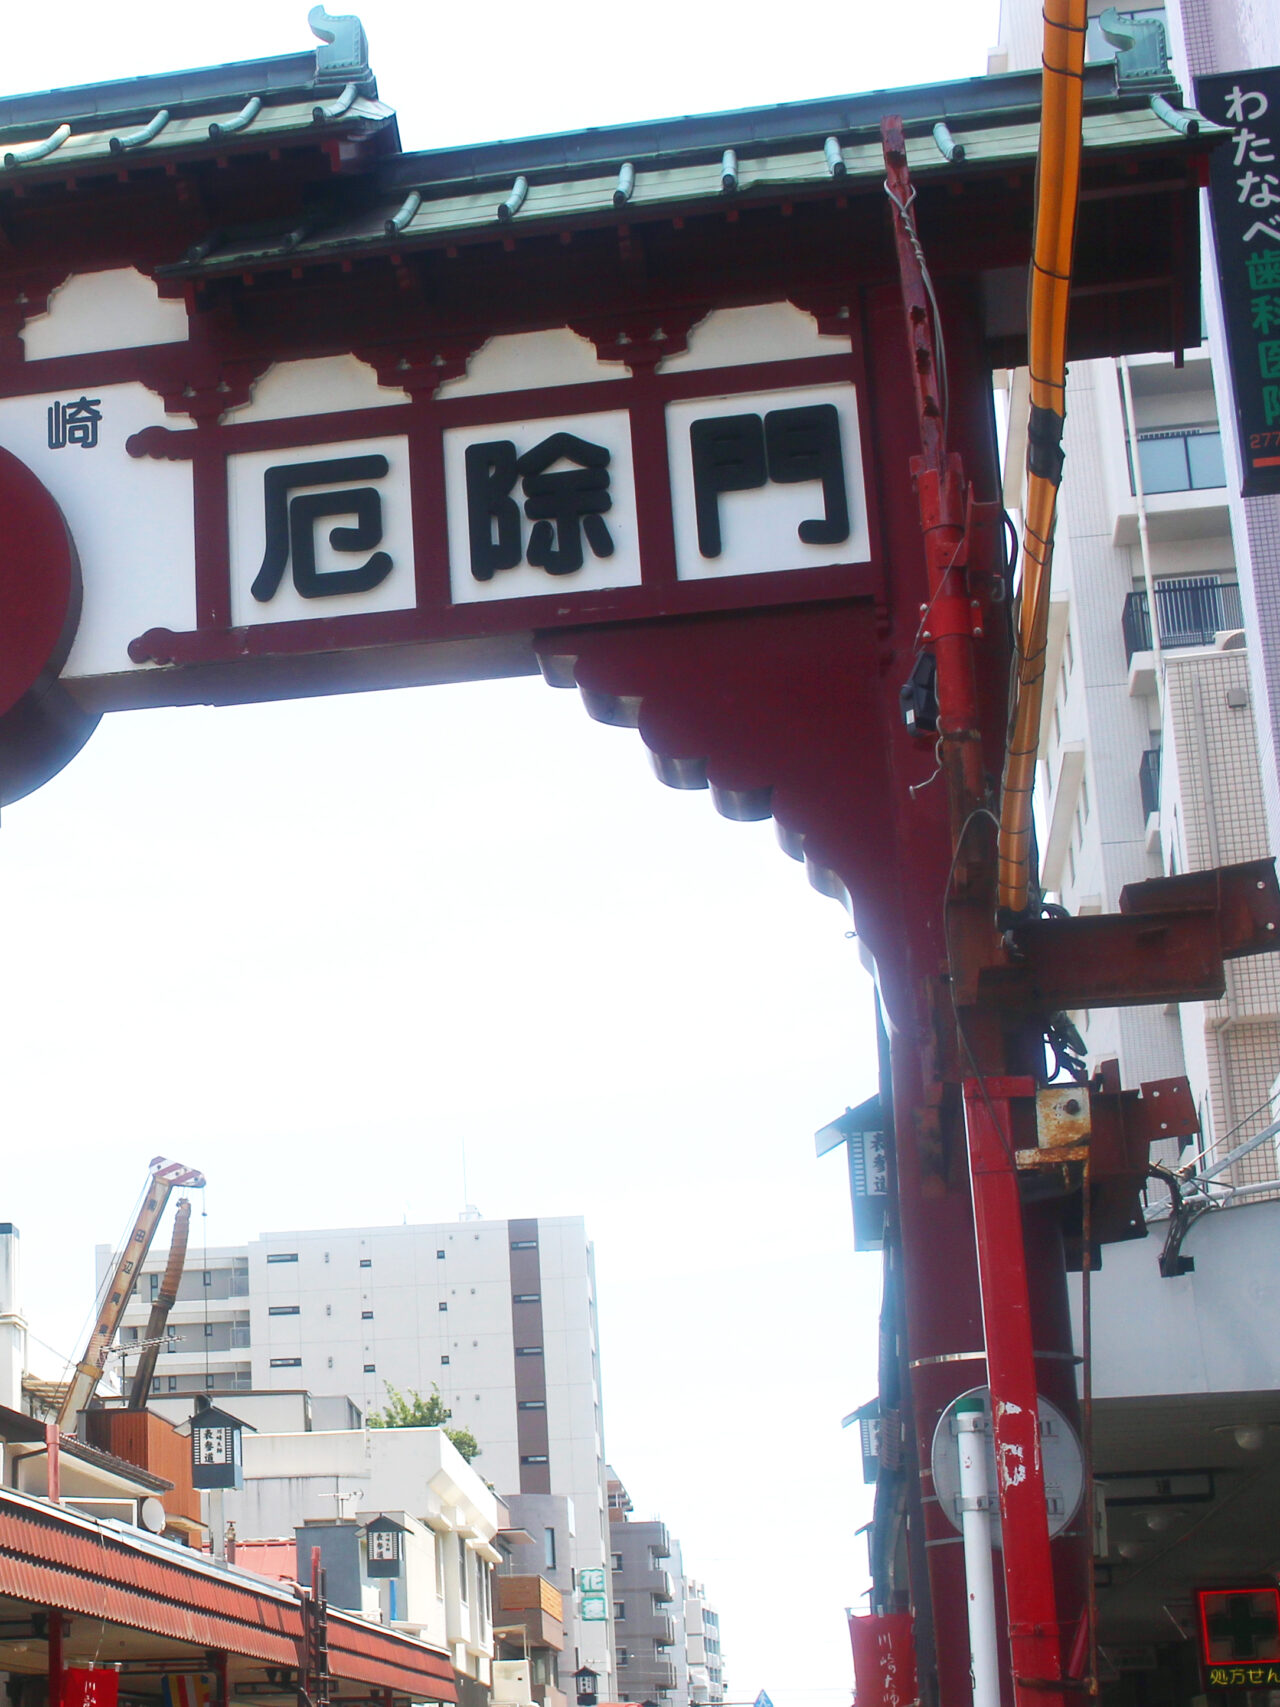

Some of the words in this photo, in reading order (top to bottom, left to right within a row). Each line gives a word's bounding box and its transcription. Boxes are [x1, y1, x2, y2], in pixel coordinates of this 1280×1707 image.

[250, 403, 850, 602] 厄除門
[1209, 1667, 1280, 1686] 処方せん
